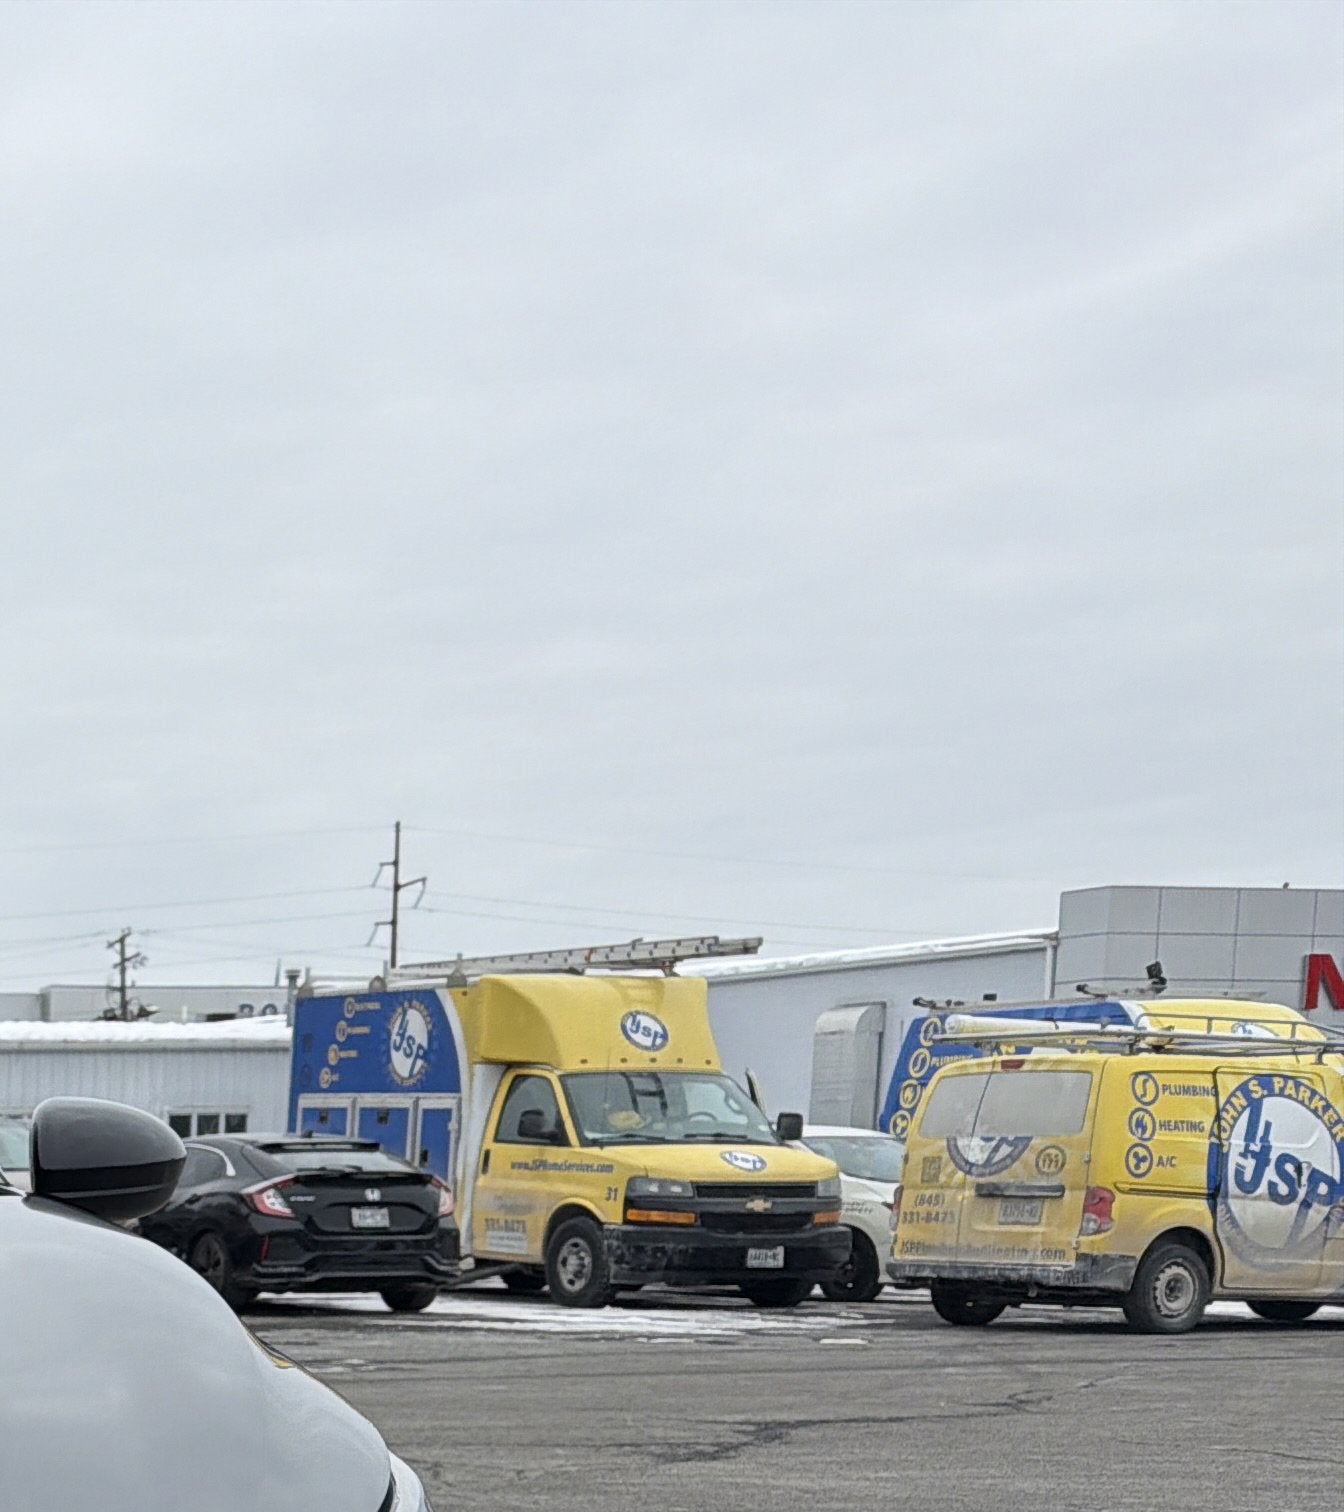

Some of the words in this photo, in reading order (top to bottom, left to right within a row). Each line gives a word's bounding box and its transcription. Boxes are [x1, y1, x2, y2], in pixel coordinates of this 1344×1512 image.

[1162, 1083, 1217, 1098] PLUMBING
[1159, 1119, 1205, 1133] HEATING
[1156, 1156, 1177, 1168] A/C
[605, 1186, 618, 1201] 31
[914, 1193, 946, 1208] (845)
